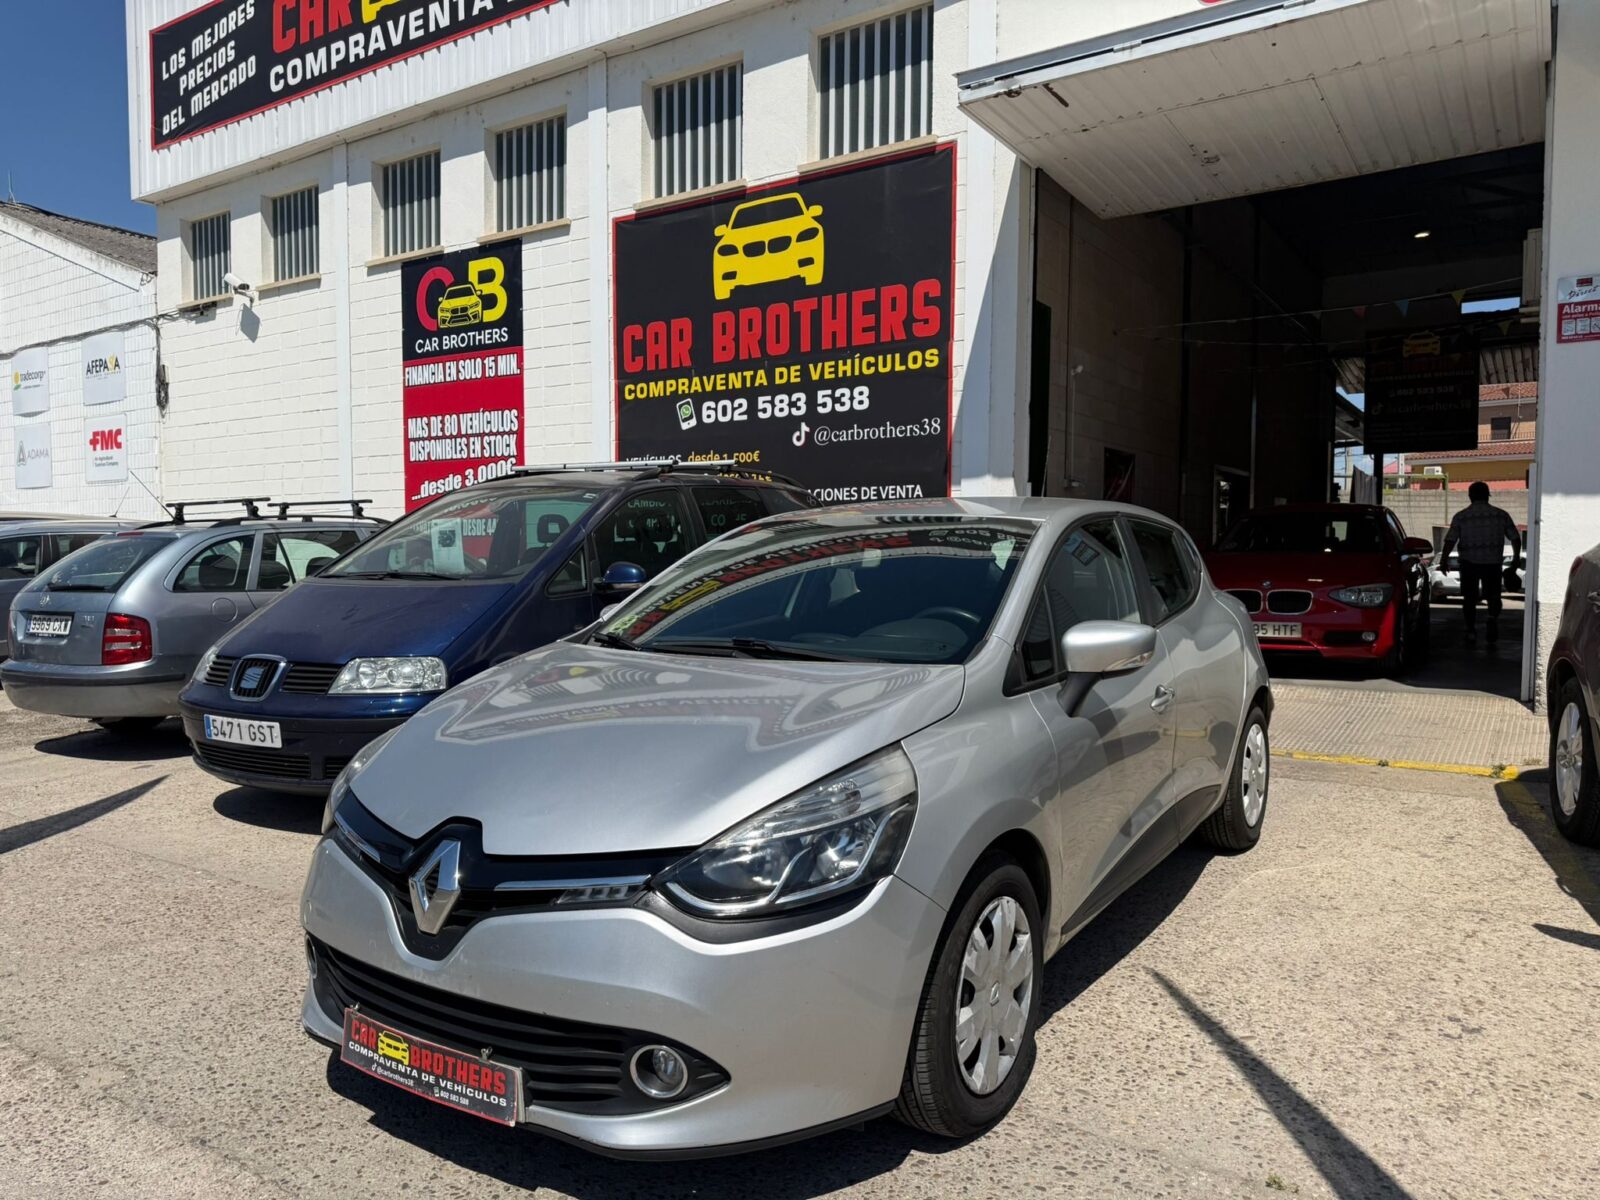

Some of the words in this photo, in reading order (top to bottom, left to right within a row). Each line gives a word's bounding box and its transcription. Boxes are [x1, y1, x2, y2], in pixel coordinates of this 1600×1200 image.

[162, 47, 186, 81] LOS
[191, 0, 256, 59] MEJORES
[269, 0, 494, 93] COMPRAVENTA
[179, 40, 236, 96] PRECIOS
[162, 105, 186, 136] DEL
[190, 55, 257, 117] MERCADO
[415, 337, 439, 354] CAR
[443, 327, 509, 351] BROTHERS
[622, 317, 693, 373] CAR
[712, 278, 942, 364] BROTHERS
[405, 362, 444, 387] FINANCIA
[446, 361, 457, 381] EN
[458, 358, 483, 380] SOLO
[484, 356, 496, 377] 15
[497, 353, 521, 376] MIN.
[624, 370, 768, 400] COMPRAVENTA
[775, 366, 801, 385] DE
[808, 348, 940, 381] VEHÍCULOS
[701, 397, 748, 424] 602
[757, 392, 807, 419] 583
[816, 386, 870, 414] 538
[89, 428, 122, 451] FMC
[408, 417, 430, 439] MAS
[431, 416, 443, 437] DE
[444, 414, 458, 436] 80
[459, 408, 519, 434] VEHÍCULOS
[814, 417, 942, 446] @carbrothers38
[409, 437, 468, 462] DISPONIBLES
[469, 436, 482, 459] EN
[483, 433, 518, 457] STOCK
[687, 450, 720, 463] desde
[861, 487, 878, 500] DE
[879, 483, 924, 499] VENTA
[463, 519, 486, 536] DESDE
[1272, 624, 1298, 635] HTF
[212, 717, 243, 742] 5471
[249, 725, 276, 744] GST
[351, 1019, 377, 1049] CAR
[410, 1044, 507, 1095] BROTHERS
[348, 1041, 419, 1079] COMPRAVENTA
[421, 1072, 436, 1085] DE
[439, 1078, 508, 1107] VEHÍCULOS
